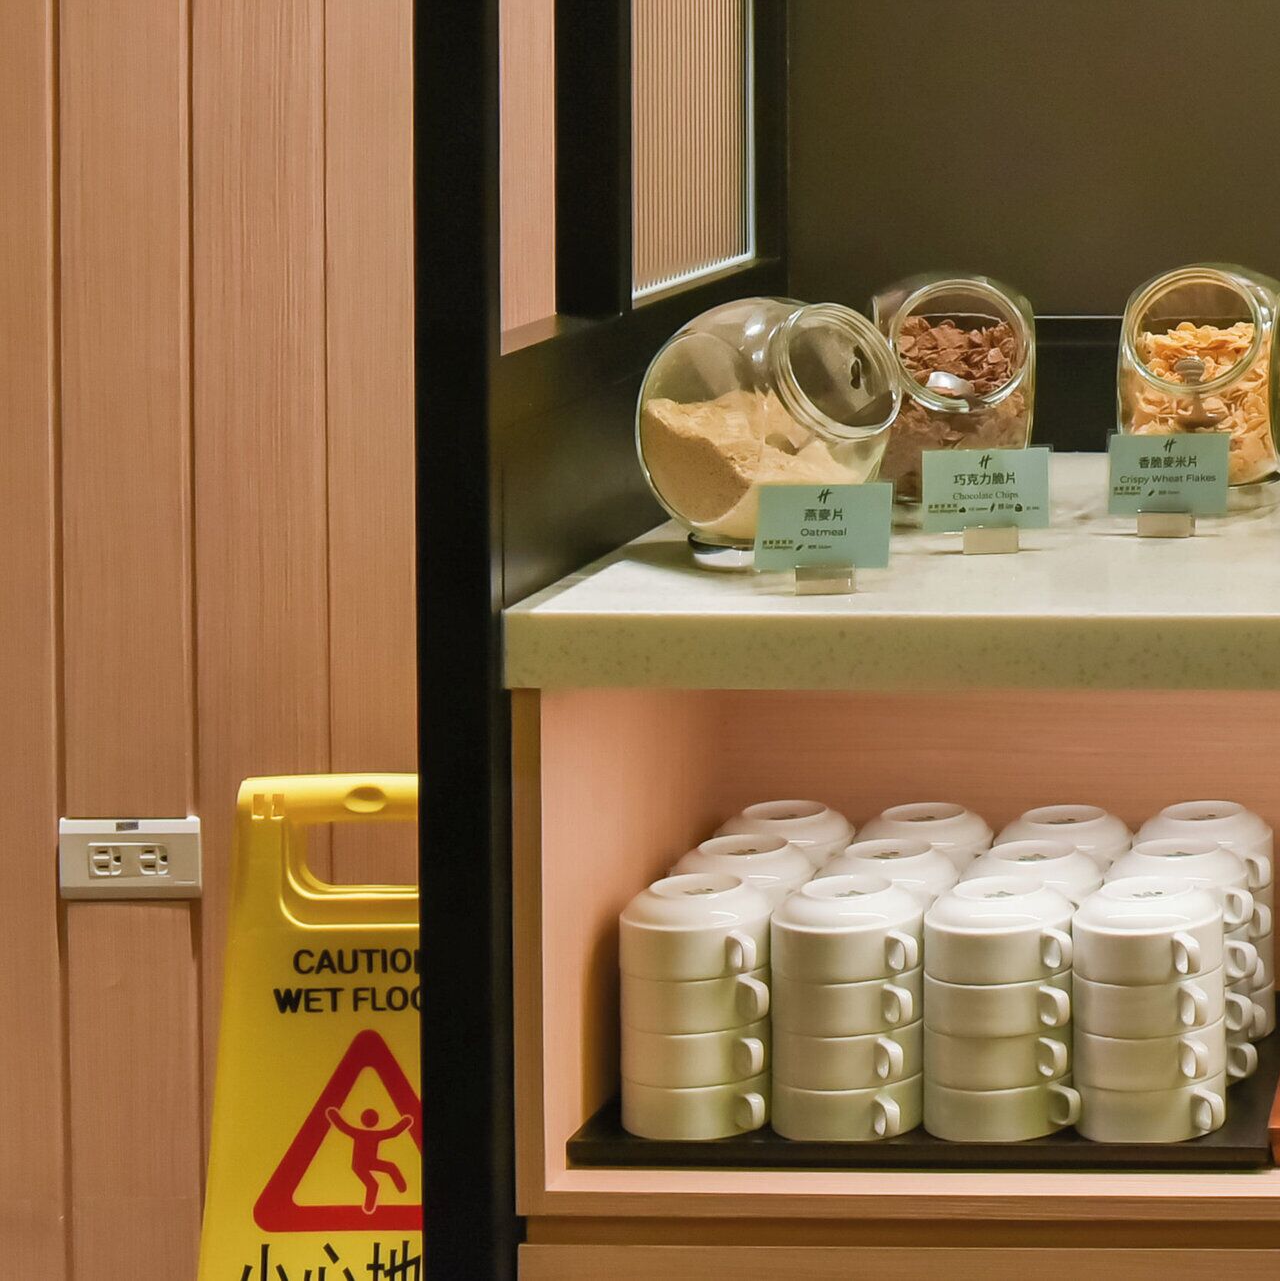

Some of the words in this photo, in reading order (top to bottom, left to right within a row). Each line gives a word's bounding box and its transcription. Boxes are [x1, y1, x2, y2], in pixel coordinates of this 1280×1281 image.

[953, 471, 1015, 486] 巧克力脆片
[1119, 475, 1149, 485] Crispy
[1152, 474, 1183, 483] Wheat
[1186, 473, 1217, 482] Flakes
[952, 491, 993, 501] Chocolate
[995, 490, 1019, 500] Chips
[804, 508, 843, 521] 燕麥片
[800, 527, 847, 537] Oatmeal
[273, 987, 345, 1014] WET
